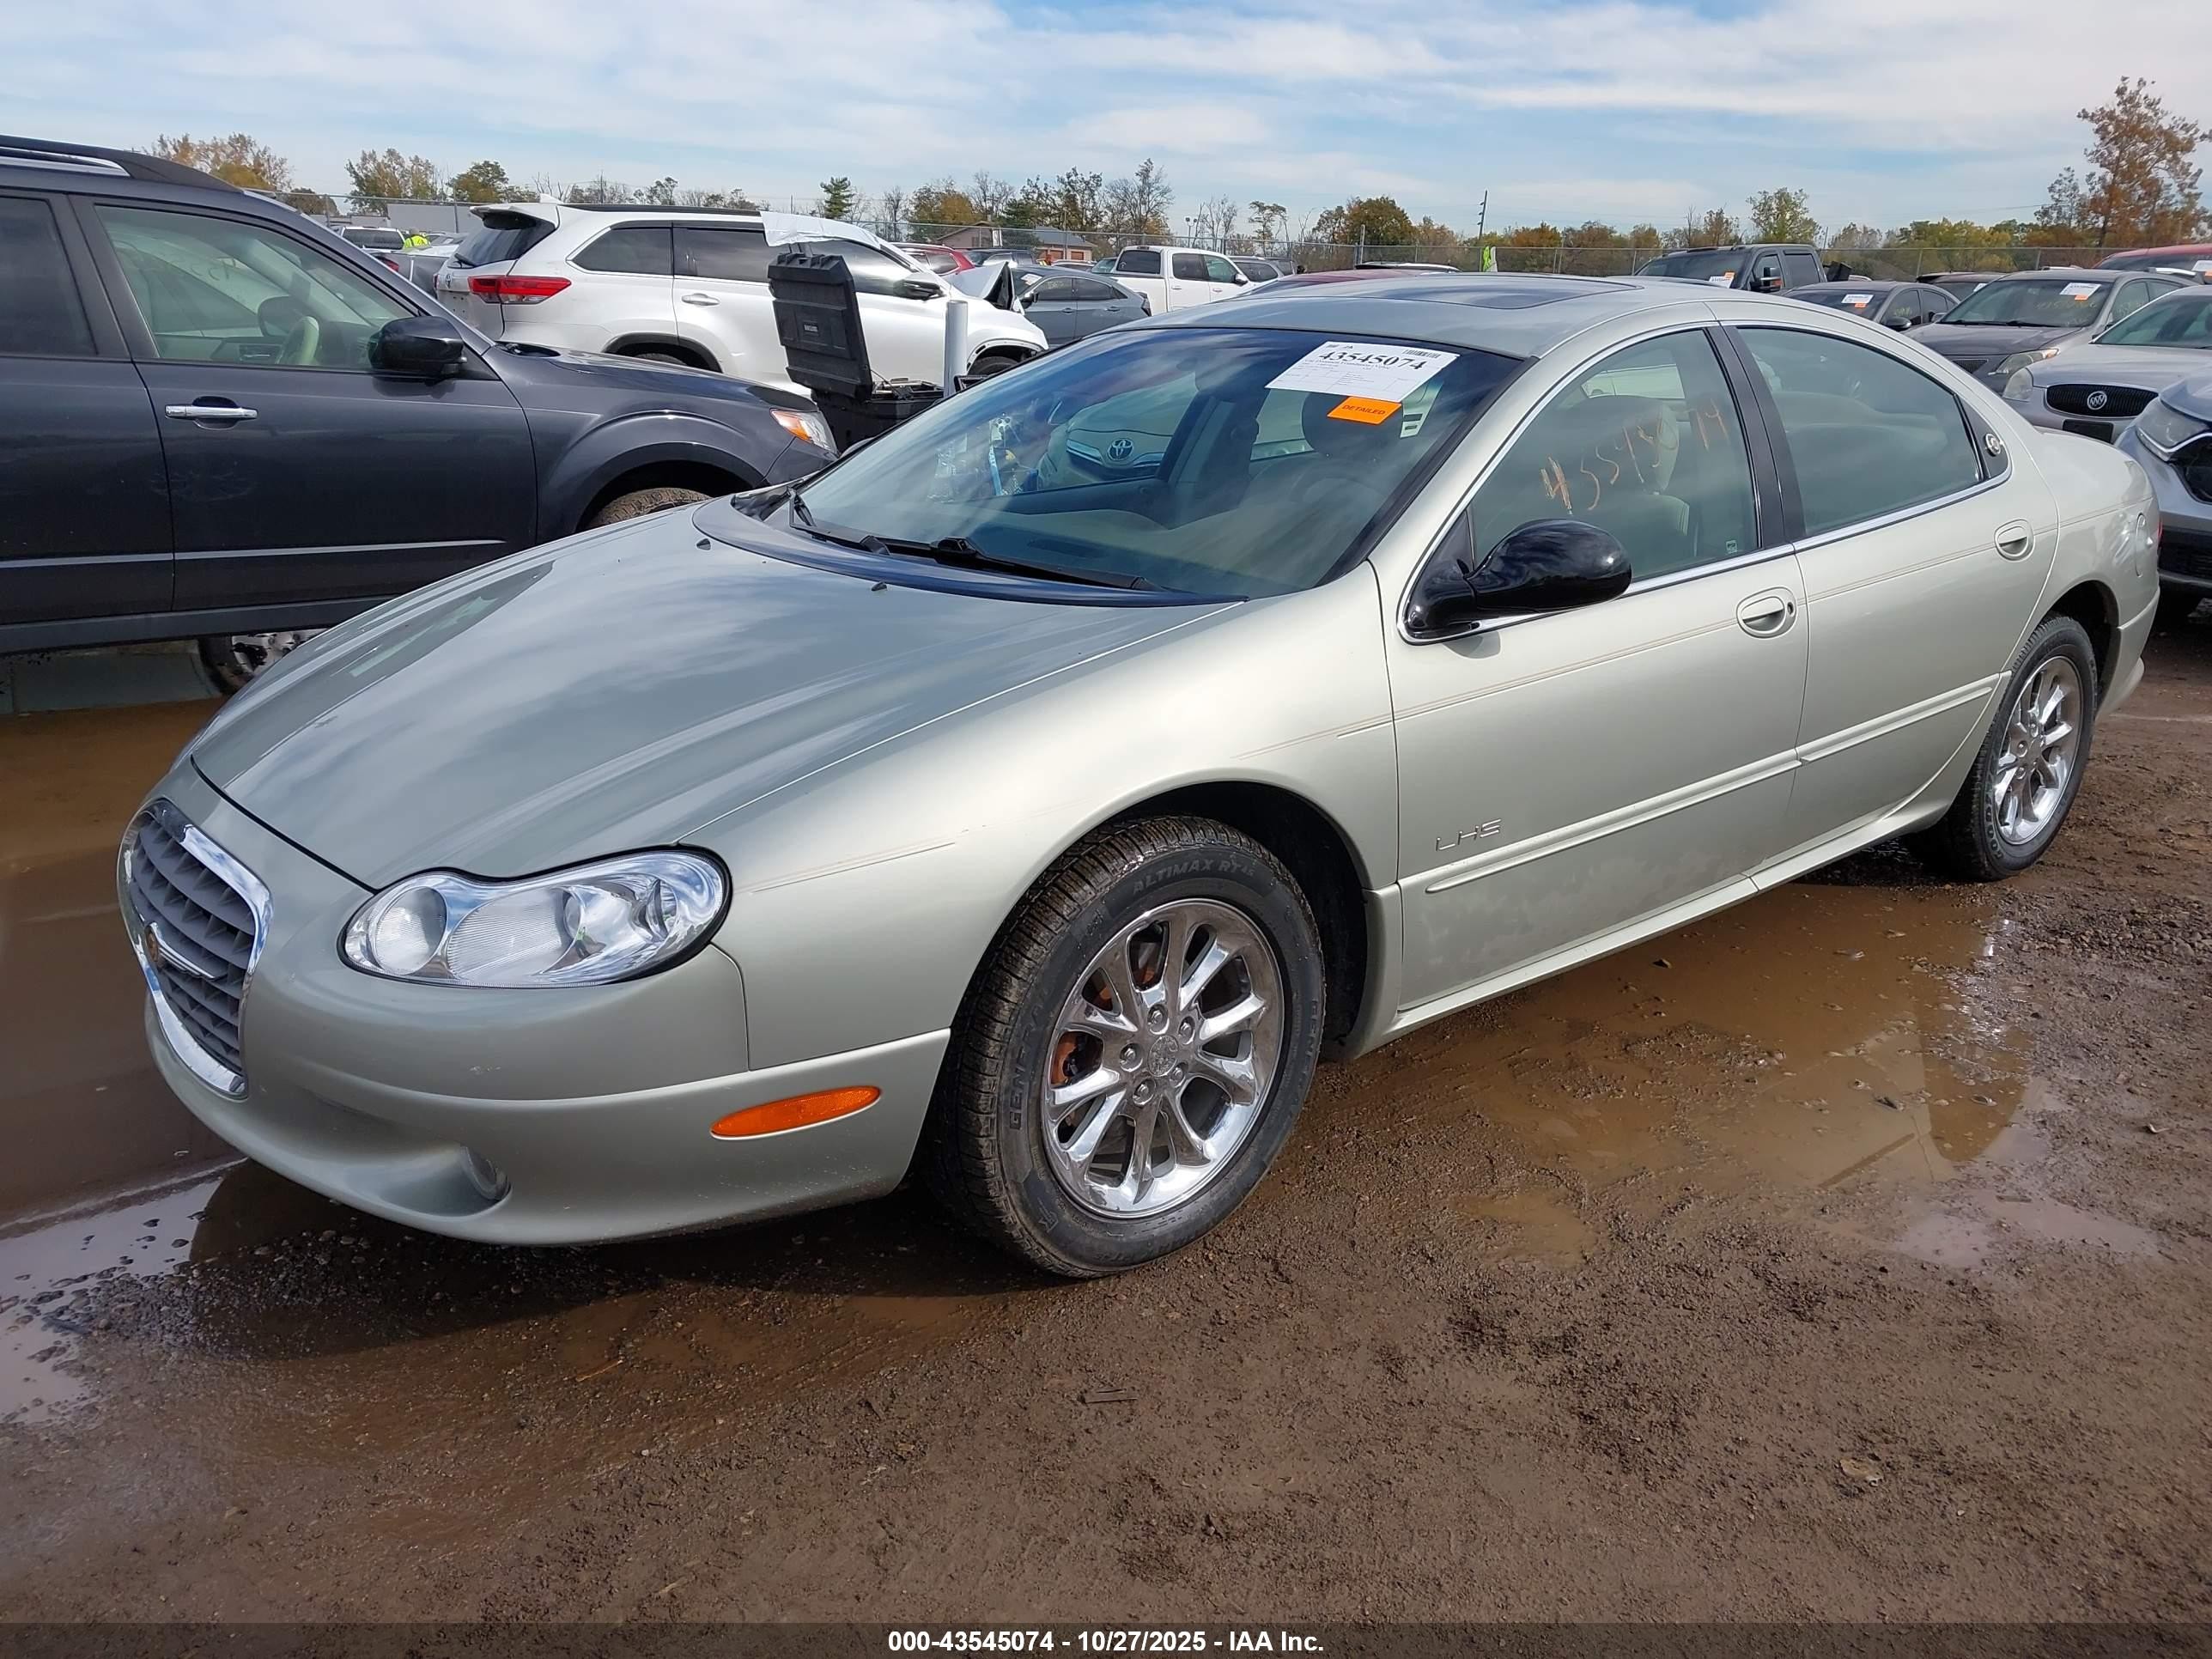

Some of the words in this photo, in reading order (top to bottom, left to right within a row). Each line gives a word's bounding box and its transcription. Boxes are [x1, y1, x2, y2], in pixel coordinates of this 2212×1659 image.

[1318, 350, 1427, 370] 43545074
[1341, 404, 1386, 416] DETAILED
[1435, 817, 1502, 852] LHS
[1133, 860, 1215, 896] ALTIMAX
